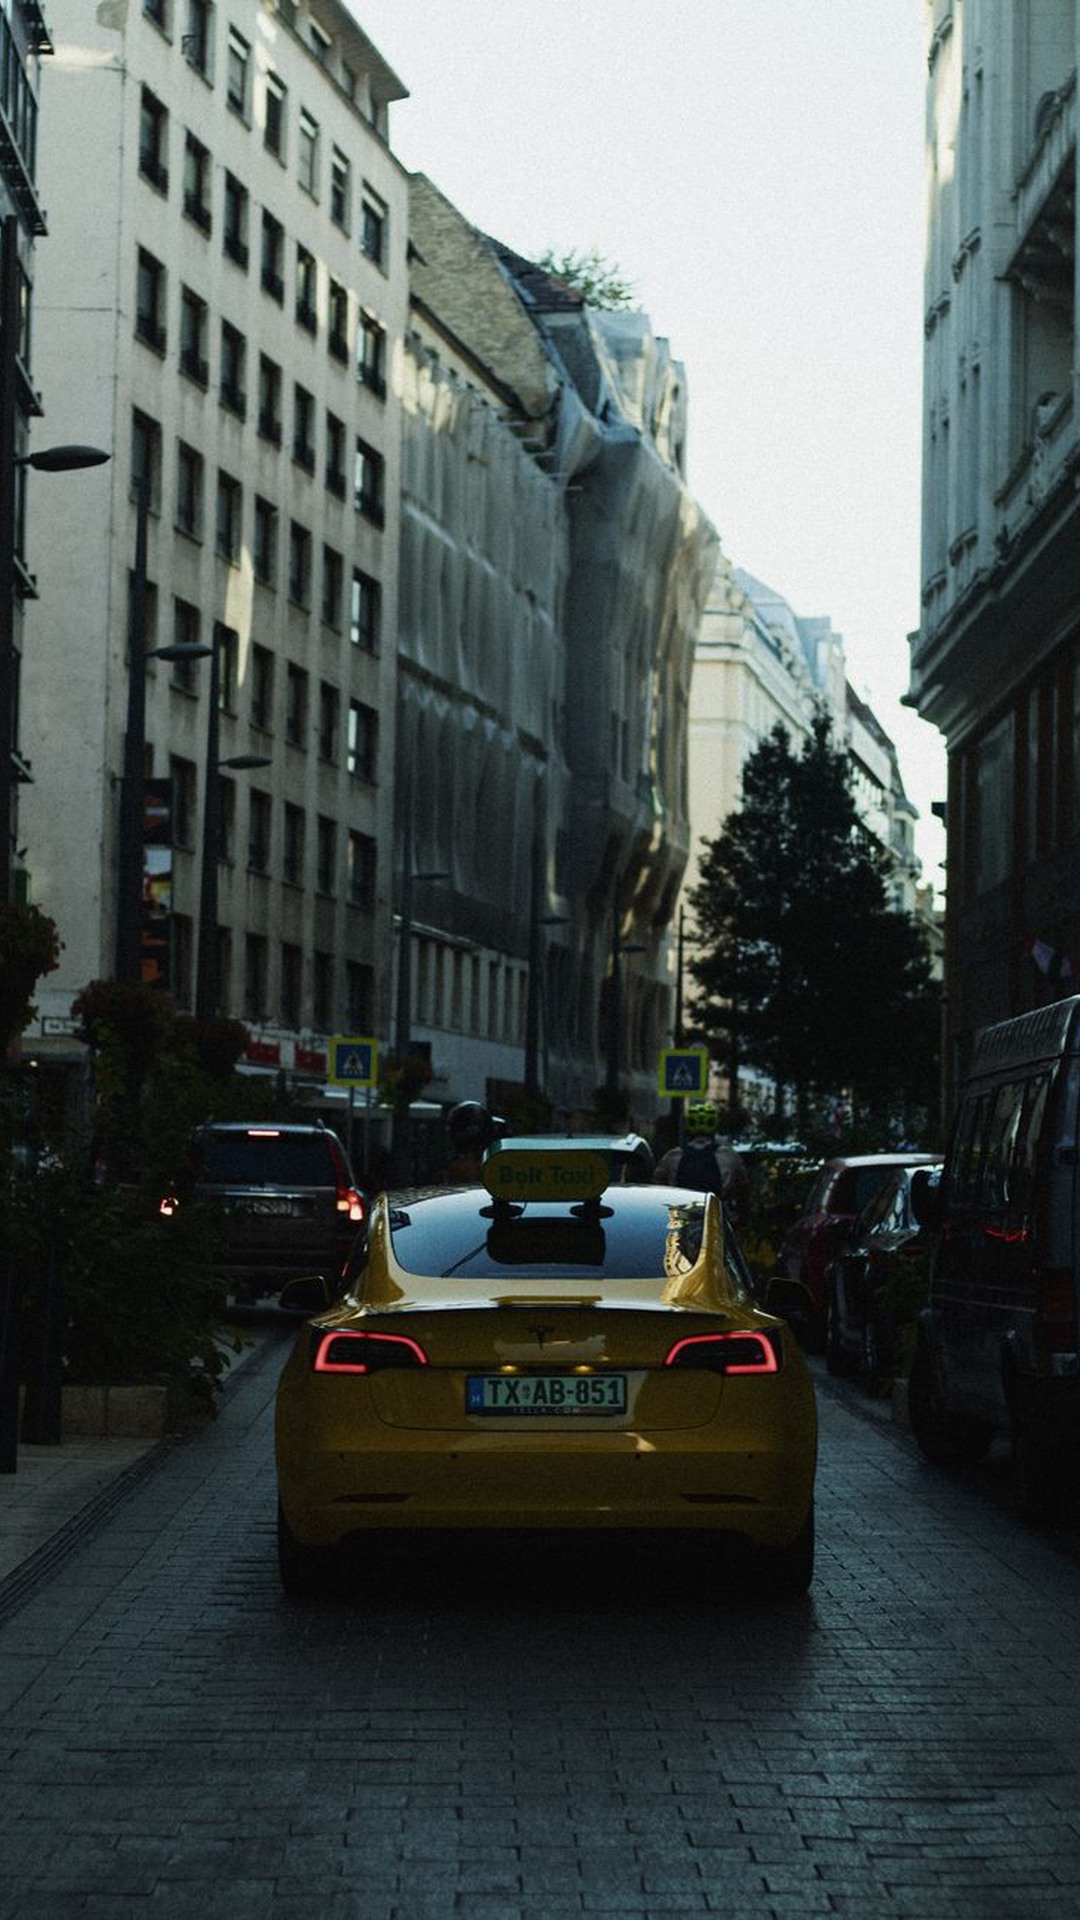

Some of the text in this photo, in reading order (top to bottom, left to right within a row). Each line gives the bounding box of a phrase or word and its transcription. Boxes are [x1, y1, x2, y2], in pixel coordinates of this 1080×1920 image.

[499, 1165, 593, 1184] Bolt Taxi
[488, 1380, 621, 1405] TX AB-851
